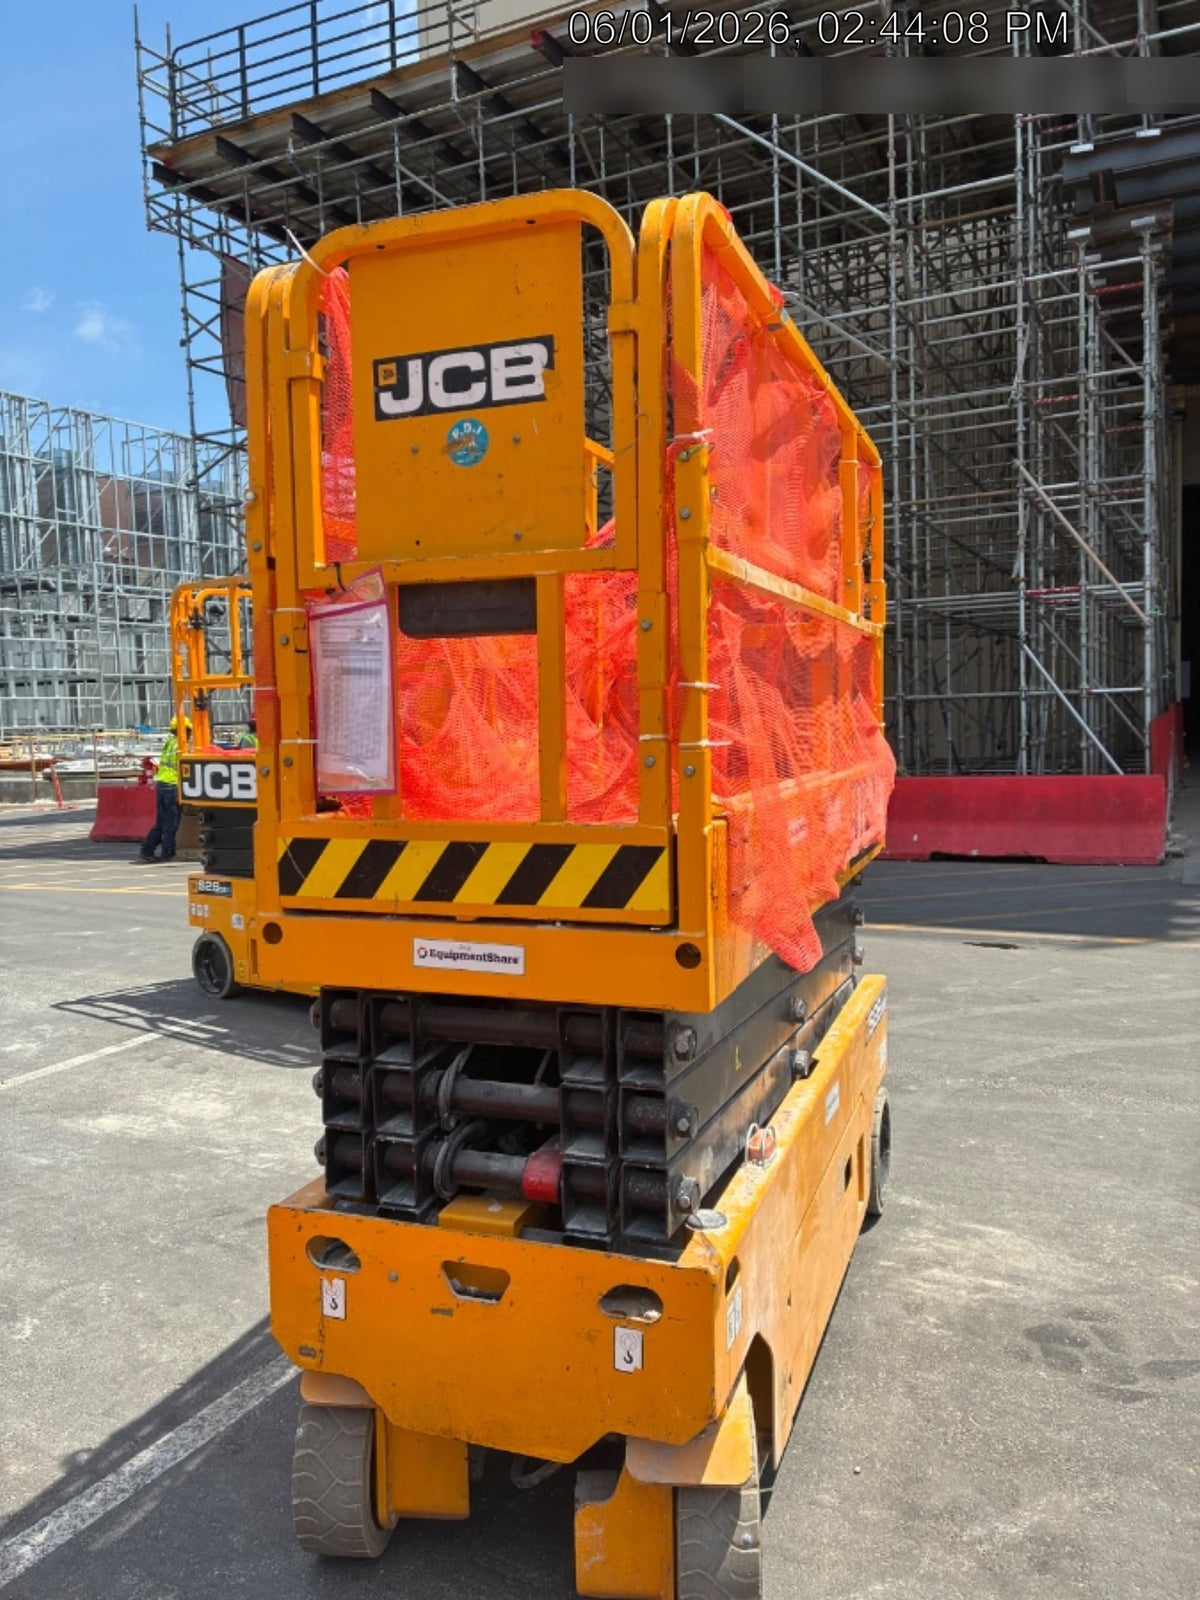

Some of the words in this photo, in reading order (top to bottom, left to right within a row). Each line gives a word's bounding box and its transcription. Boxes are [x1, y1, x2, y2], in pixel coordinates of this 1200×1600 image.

[378, 342, 549, 415] JCB
[182, 763, 257, 799] JCB
[429, 948, 520, 965] EquipmentShare
